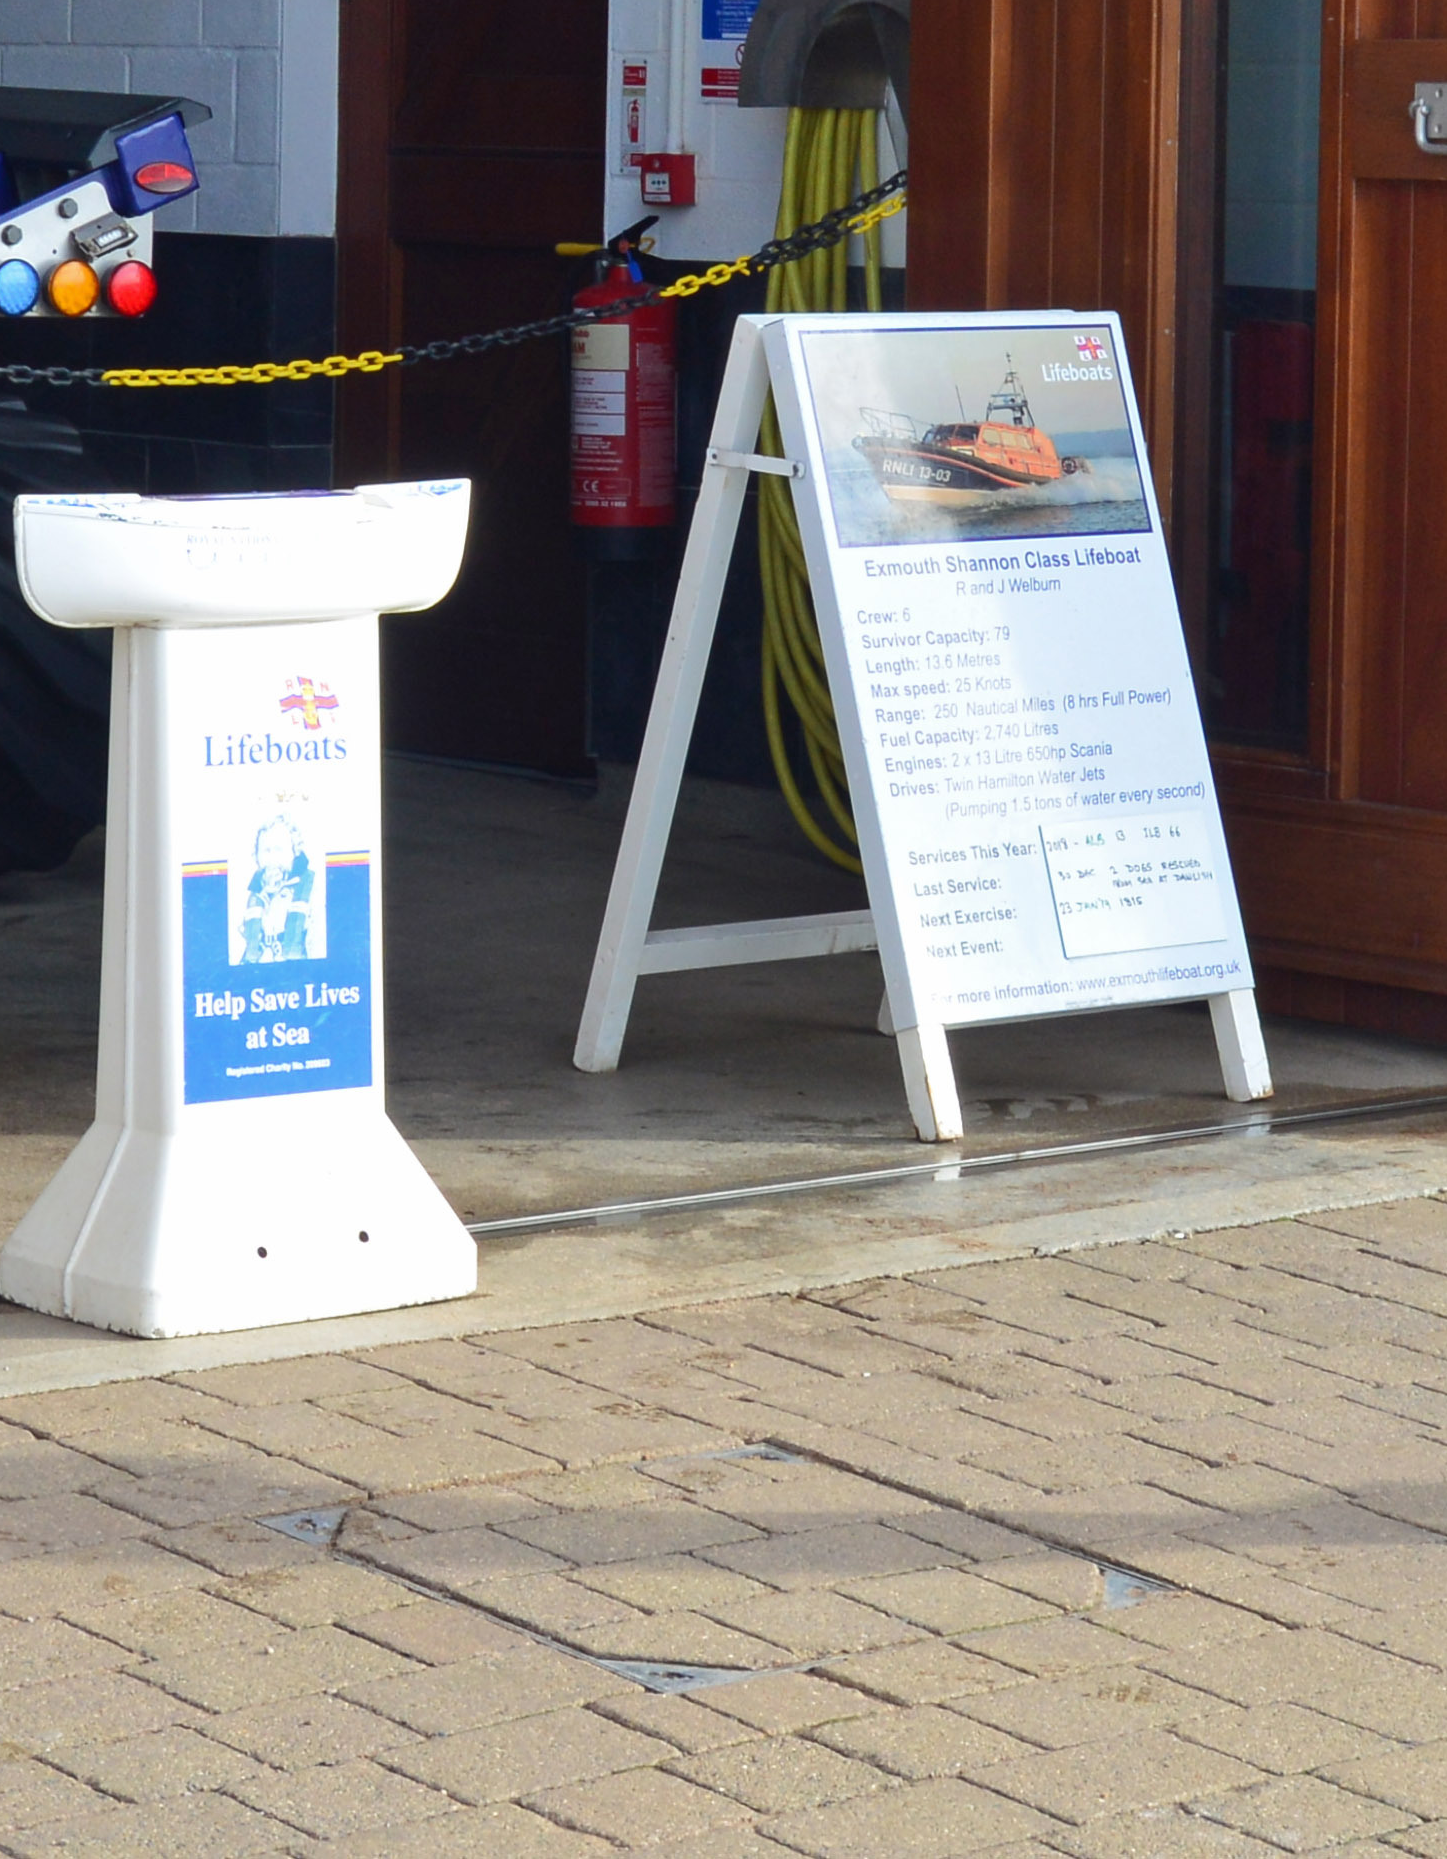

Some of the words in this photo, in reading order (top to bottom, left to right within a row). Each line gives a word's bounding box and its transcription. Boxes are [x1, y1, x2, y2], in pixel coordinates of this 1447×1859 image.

[1041, 363, 1113, 383] Lifeboats
[882, 458, 915, 477] RNLI
[919, 465, 952, 483] 13-03
[864, 556, 941, 578] Exmouth
[945, 553, 1021, 573] Shannon
[1024, 550, 1071, 570] Class
[1074, 546, 1142, 567] Lifeboat
[956, 581, 966, 596] R
[970, 579, 994, 595] and
[997, 579, 1005, 594] J
[1008, 578, 1062, 593] Welburn
[857, 609, 898, 625] Crew:
[902, 607, 911, 622] 6
[861, 632, 921, 649] Survivor
[925, 628, 990, 647] Capacity:
[994, 626, 1011, 641] 79
[865, 656, 920, 676] Length:
[925, 654, 953, 670] 13.6
[957, 653, 1001, 669] Metres
[870, 683, 900, 699] Max
[904, 679, 950, 699] speed:
[955, 677, 972, 693] 25
[975, 676, 1012, 692] Knots
[875, 707, 925, 725] Range:
[933, 703, 958, 719] 250
[966, 698, 1018, 717] Nautical
[1022, 697, 1056, 713] Miles
[1063, 694, 1075, 713] (8
[1079, 693, 1098, 708] hrs
[1102, 691, 1125, 707] Full
[1128, 687, 1172, 705] Power)
[879, 731, 911, 748] Fuel
[914, 728, 980, 747] Capacity:
[983, 723, 1020, 743] 2,740
[1024, 722, 1059, 738] Litres
[204, 732, 347, 767] Lifeboats
[885, 755, 948, 775] Engines:
[952, 752, 960, 768] 2
[963, 755, 971, 766] x
[976, 751, 991, 766] 13
[995, 749, 1023, 764] Litre
[1027, 744, 1066, 762] 650hp
[1070, 741, 1113, 759] Scania
[889, 781, 940, 797] Drives:
[944, 776, 974, 793] Twin
[978, 774, 1034, 790] Hamilton
[1038, 769, 1076, 785] Water
[1080, 767, 1105, 782] Jets
[945, 799, 1007, 821] (Pumping
[1012, 796, 1031, 812] 1.5
[1034, 795, 1062, 810] tons
[1065, 792, 1078, 808] of
[1081, 790, 1116, 806] water
[1119, 788, 1153, 804] every
[1157, 781, 1205, 800] second)
[908, 848, 967, 866] Services
[970, 844, 1000, 860] This
[1002, 842, 1038, 858] Year:
[1125, 862, 1153, 873] DOGS
[913, 882, 945, 897] Last
[947, 876, 1002, 894] Service:
[920, 911, 951, 928] Next
[954, 906, 1018, 925] Exercise:
[926, 943, 958, 958] Next
[960, 938, 1004, 956] Event:
[957, 986, 991, 1004] more
[994, 979, 1075, 1001] information:
[1075, 958, 1242, 992] www.exmouthlifeboat.org.uk
[194, 987, 246, 1019] Help
[250, 987, 299, 1015] Save
[306, 982, 361, 1008] Lives
[246, 1026, 268, 1050] at
[272, 1022, 310, 1048] Sea
